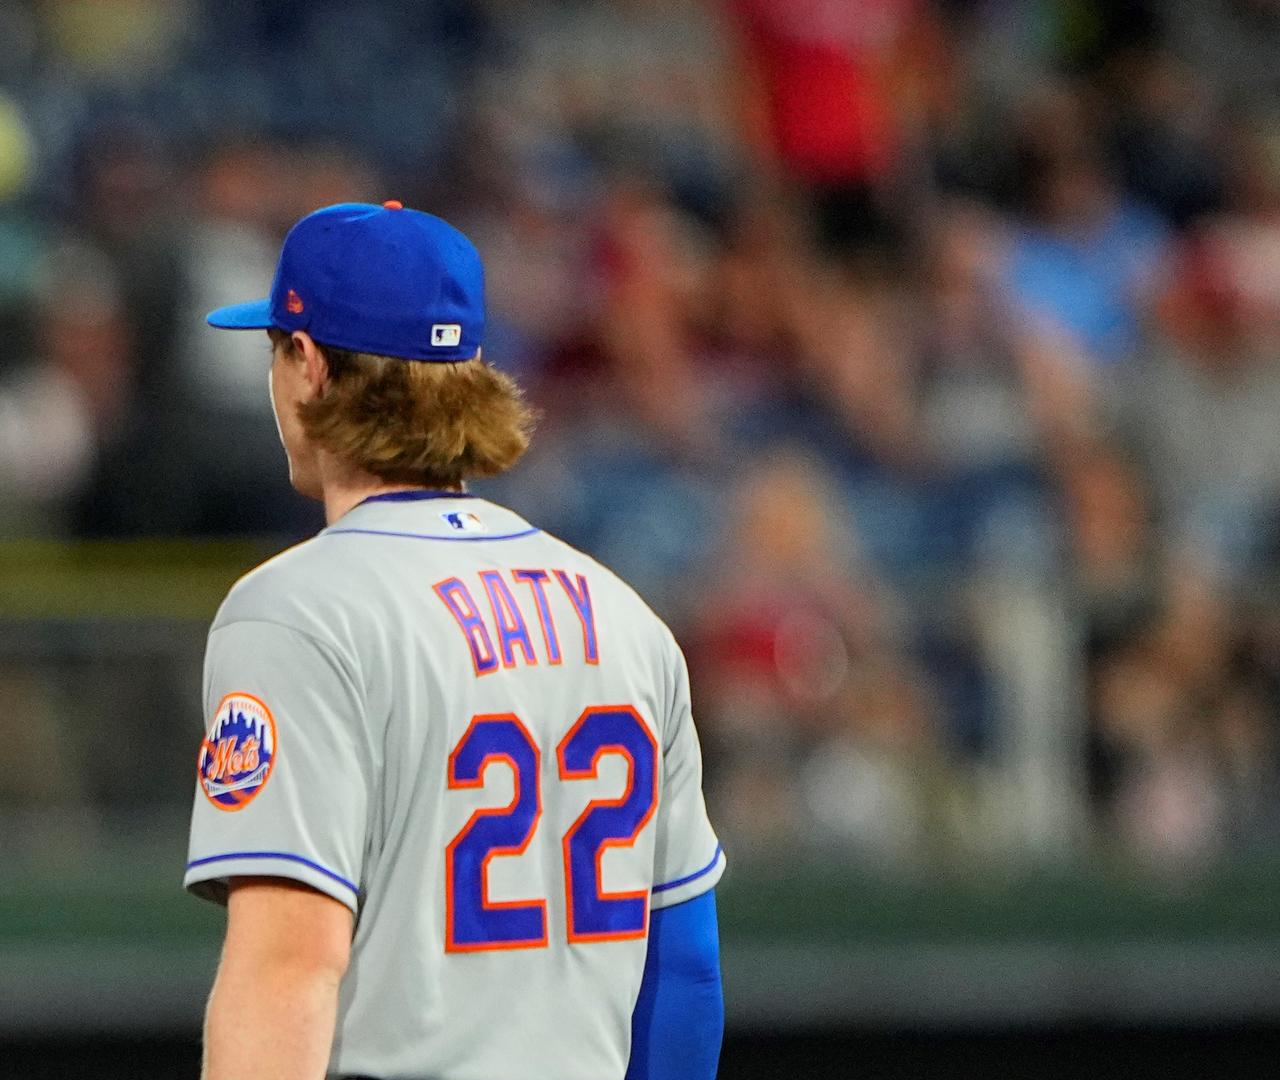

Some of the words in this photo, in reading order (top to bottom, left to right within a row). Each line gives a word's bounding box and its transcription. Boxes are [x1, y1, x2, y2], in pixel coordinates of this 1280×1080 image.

[432, 568, 600, 677] BATY
[206, 734, 261, 781] Mets
[444, 704, 659, 954] 22
